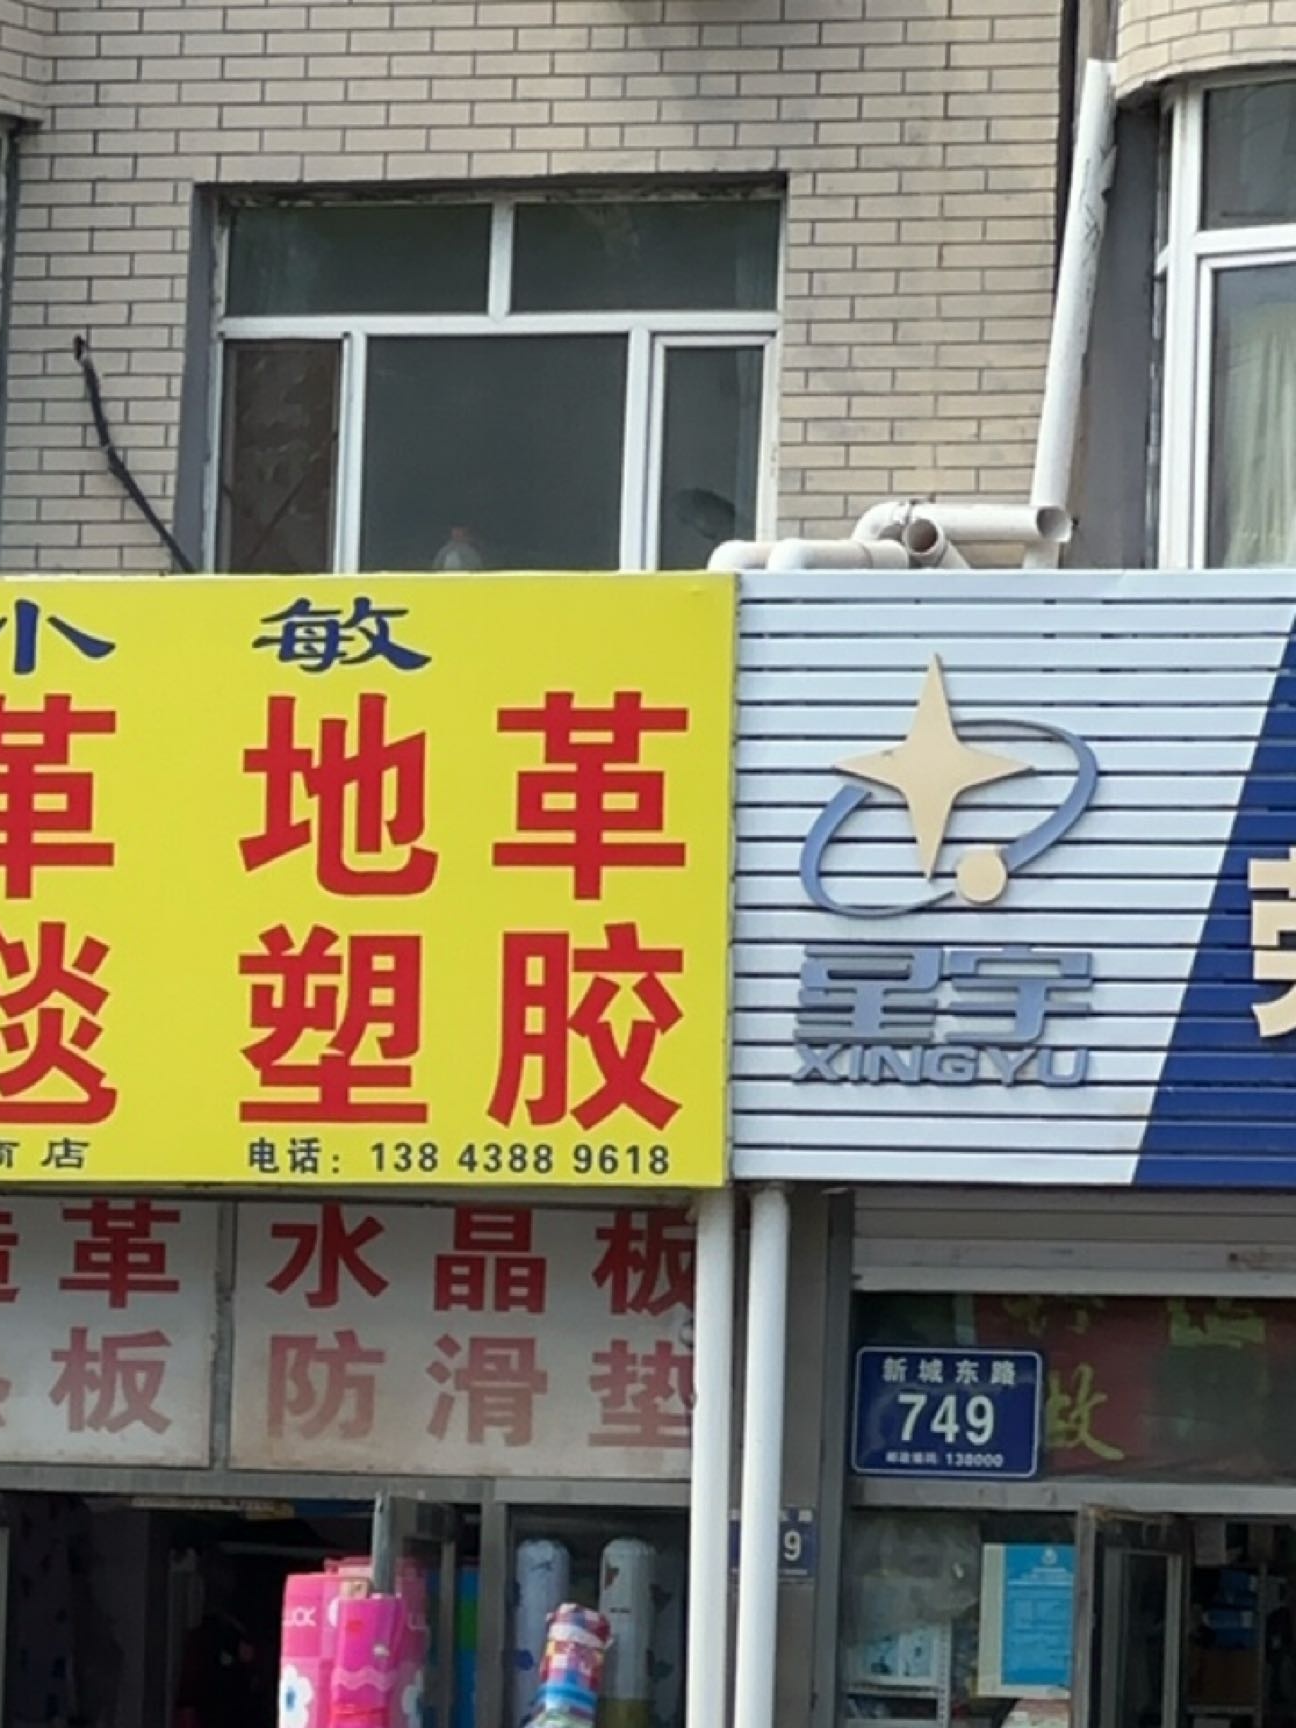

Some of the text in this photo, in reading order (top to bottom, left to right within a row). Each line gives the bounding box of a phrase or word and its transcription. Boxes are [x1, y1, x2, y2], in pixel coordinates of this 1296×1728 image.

[238, 691, 688, 899] 地革
[238, 922, 684, 1131] 塑胶
[792, 1047, 1092, 1087] XINGYU
[370, 1142, 439, 1173] 138
[457, 1142, 554, 1174] 4388
[572, 1143, 670, 1175] 9618
[268, 1204, 697, 1317] 水晶板
[266, 1330, 697, 1448] 防滑垫
[882, 1356, 1016, 1386] 新城东路
[897, 1393, 995, 1446] 749
